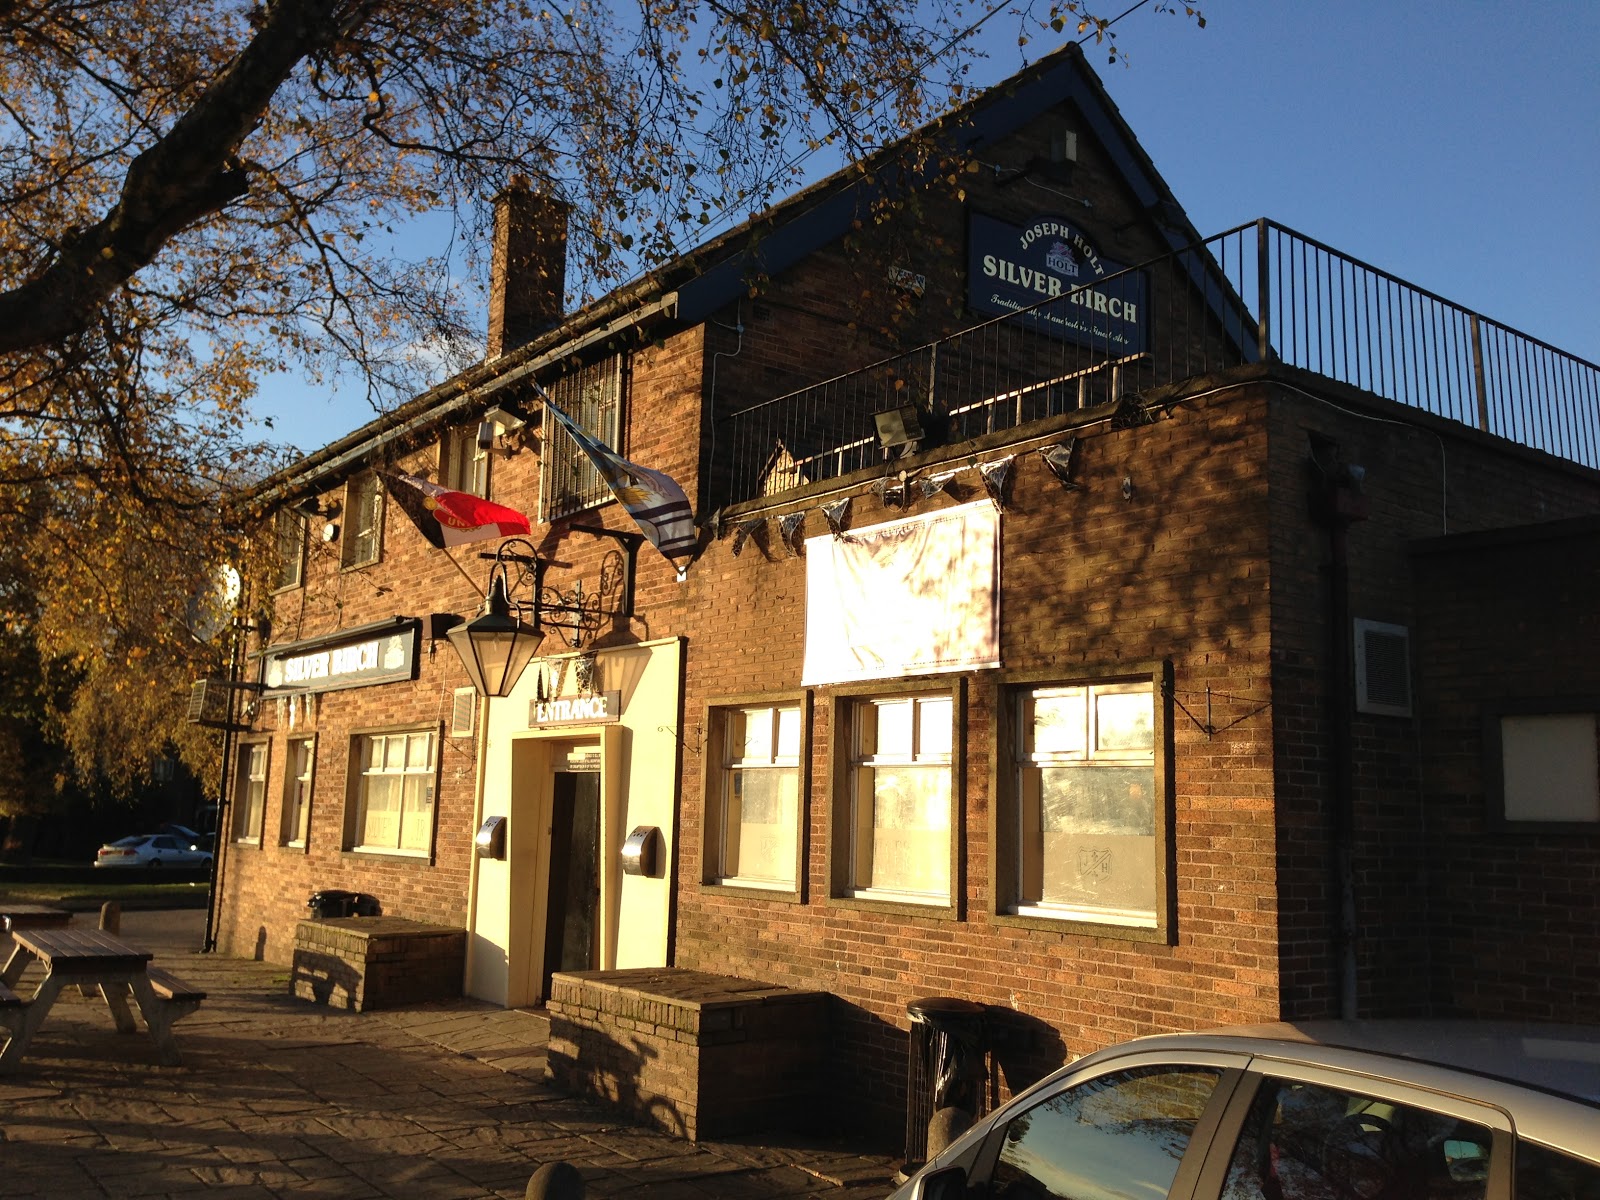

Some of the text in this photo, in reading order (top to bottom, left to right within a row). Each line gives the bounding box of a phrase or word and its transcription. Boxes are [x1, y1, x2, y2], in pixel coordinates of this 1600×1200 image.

[1019, 223, 1104, 275] JOSEPH HOLT
[1048, 256, 1077, 273] HOLT
[983, 255, 1137, 323] SILVER BIRCH
[284, 653, 330, 683] SILVER
[331, 642, 379, 675] BIRCH
[537, 697, 608, 722] ENTRANCE
